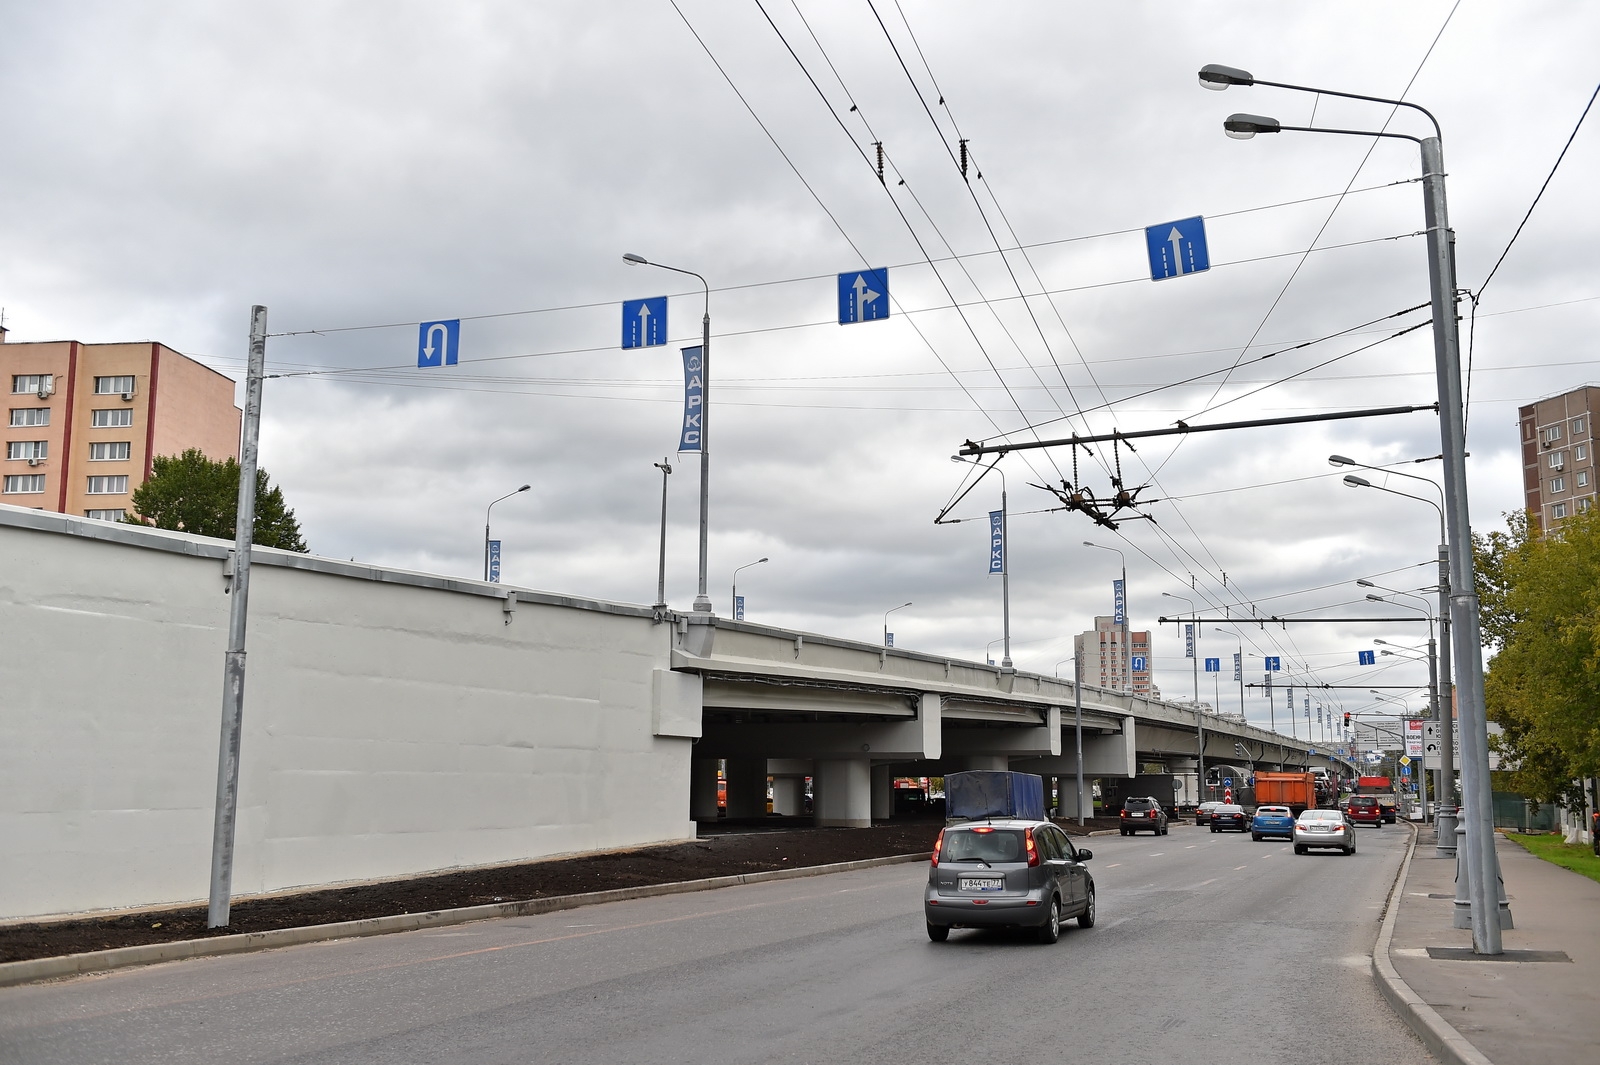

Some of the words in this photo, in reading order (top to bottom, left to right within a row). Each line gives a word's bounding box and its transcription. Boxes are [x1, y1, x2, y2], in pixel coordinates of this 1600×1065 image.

[684, 375, 702, 444] АРКС
[992, 527, 1002, 569] АРКС
[1115, 591, 1123, 622] АРКС
